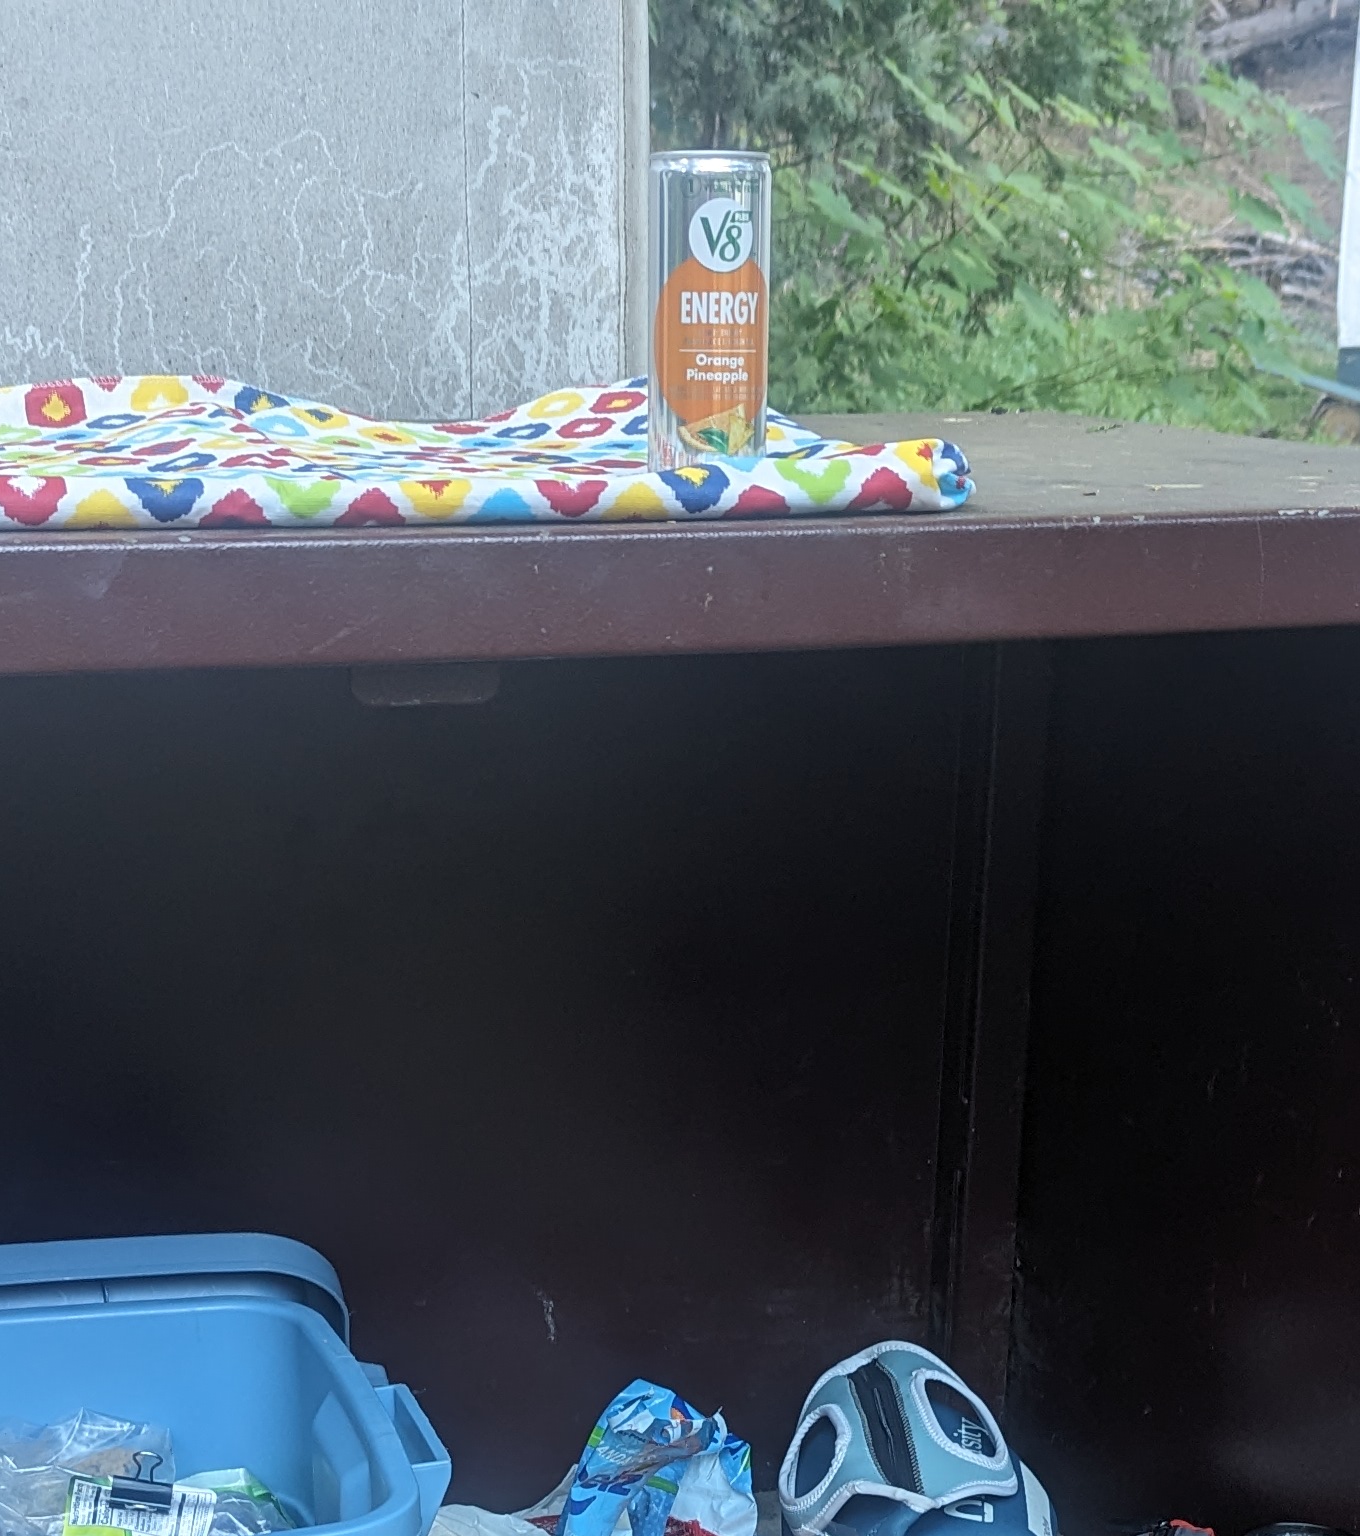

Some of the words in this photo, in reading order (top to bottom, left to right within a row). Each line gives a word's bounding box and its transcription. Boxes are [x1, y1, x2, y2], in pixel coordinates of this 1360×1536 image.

[700, 210, 742, 262] V8
[680, 291, 759, 324] ENERGY
[695, 353, 745, 369] Orange
[686, 368, 749, 384] Pineapple
